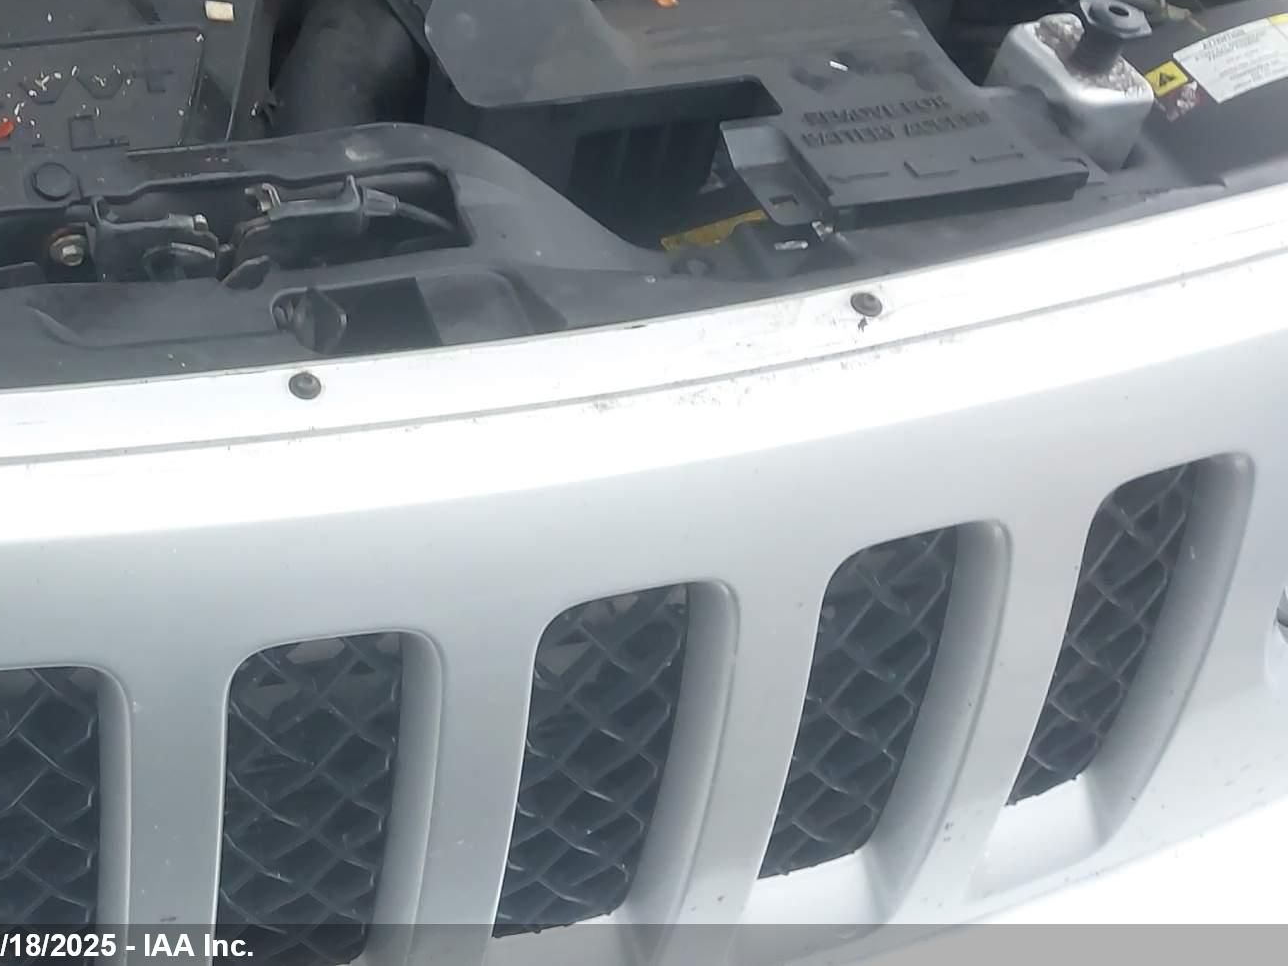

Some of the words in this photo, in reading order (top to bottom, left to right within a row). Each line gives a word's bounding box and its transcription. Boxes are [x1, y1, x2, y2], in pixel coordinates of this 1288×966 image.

[801, 104, 895, 126] REMOVE
[899, 95, 951, 115] FOR
[800, 123, 896, 146] BATTERY
